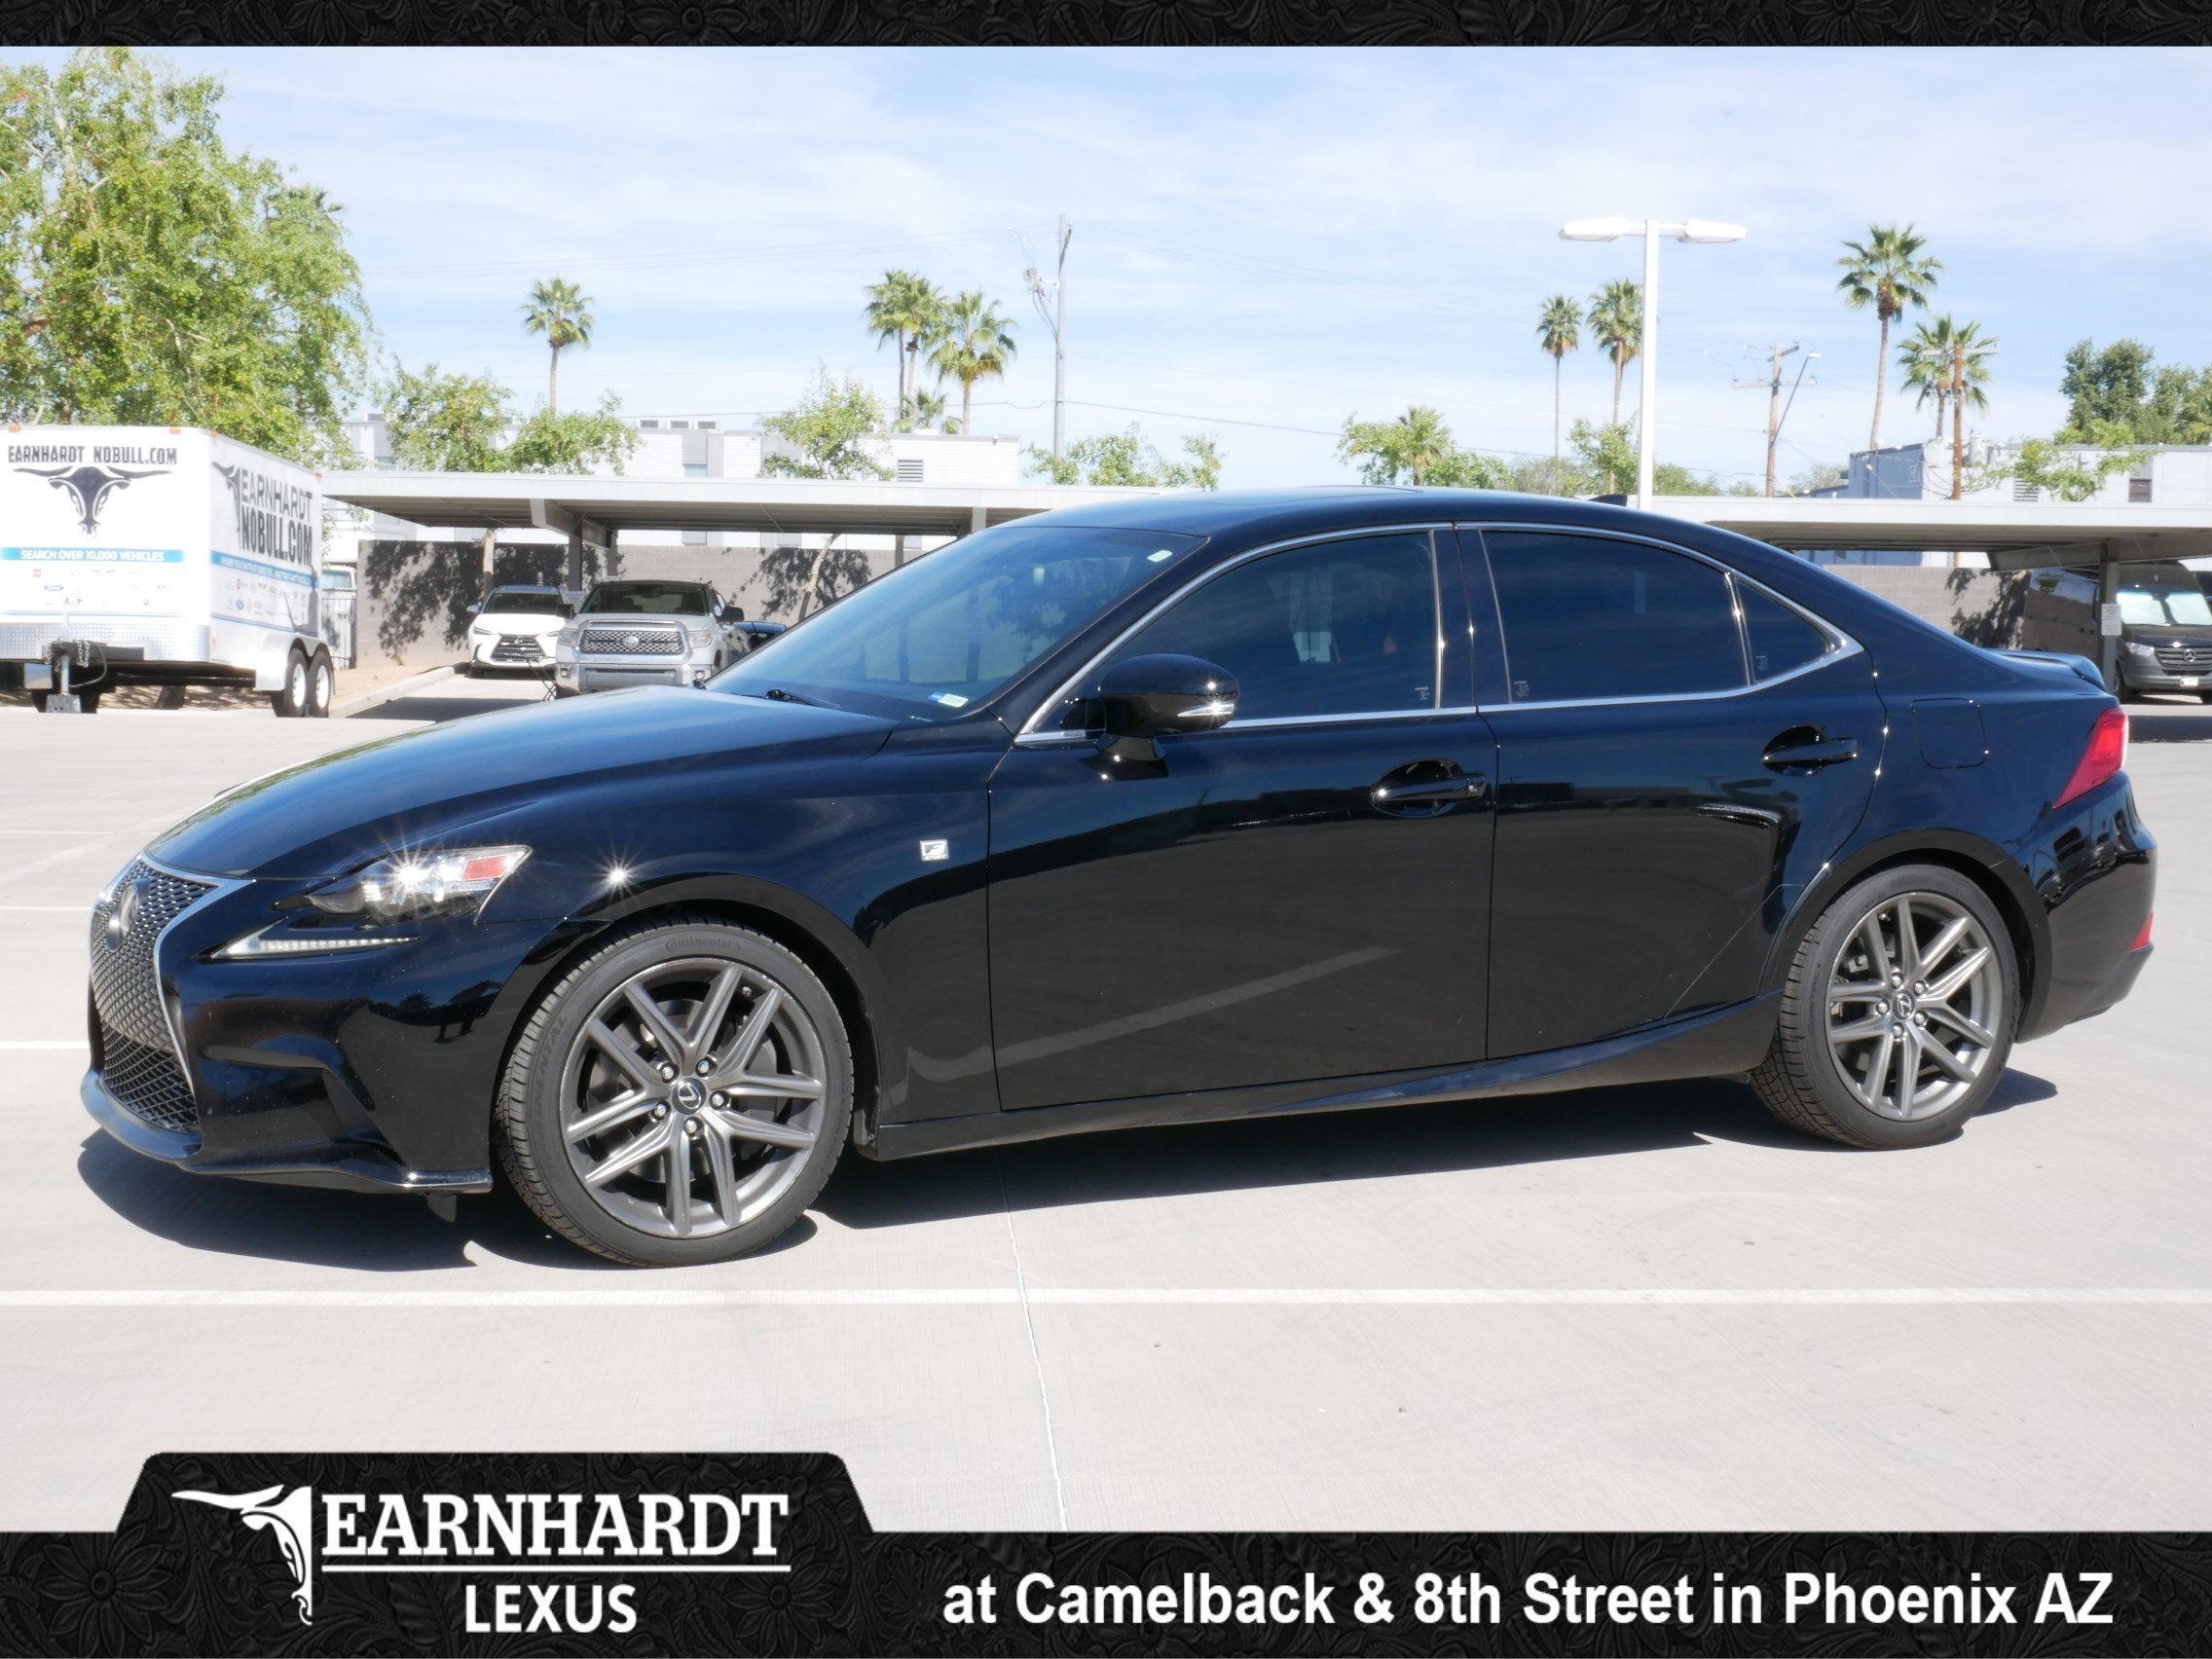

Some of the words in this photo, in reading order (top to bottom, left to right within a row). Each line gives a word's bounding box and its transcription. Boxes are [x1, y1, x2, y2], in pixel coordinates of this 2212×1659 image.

[8, 446, 85, 462] EARNHARDT
[93, 446, 177, 464] NOBULL.COM
[241, 468, 313, 523] EARNHARDT
[241, 504, 313, 567] NOBULL.COM
[20, 550, 56, 560] SEARCH
[58, 550, 84, 560] OVER
[120, 551, 165, 562] VEHICLES
[666, 937, 732, 951] Continental
